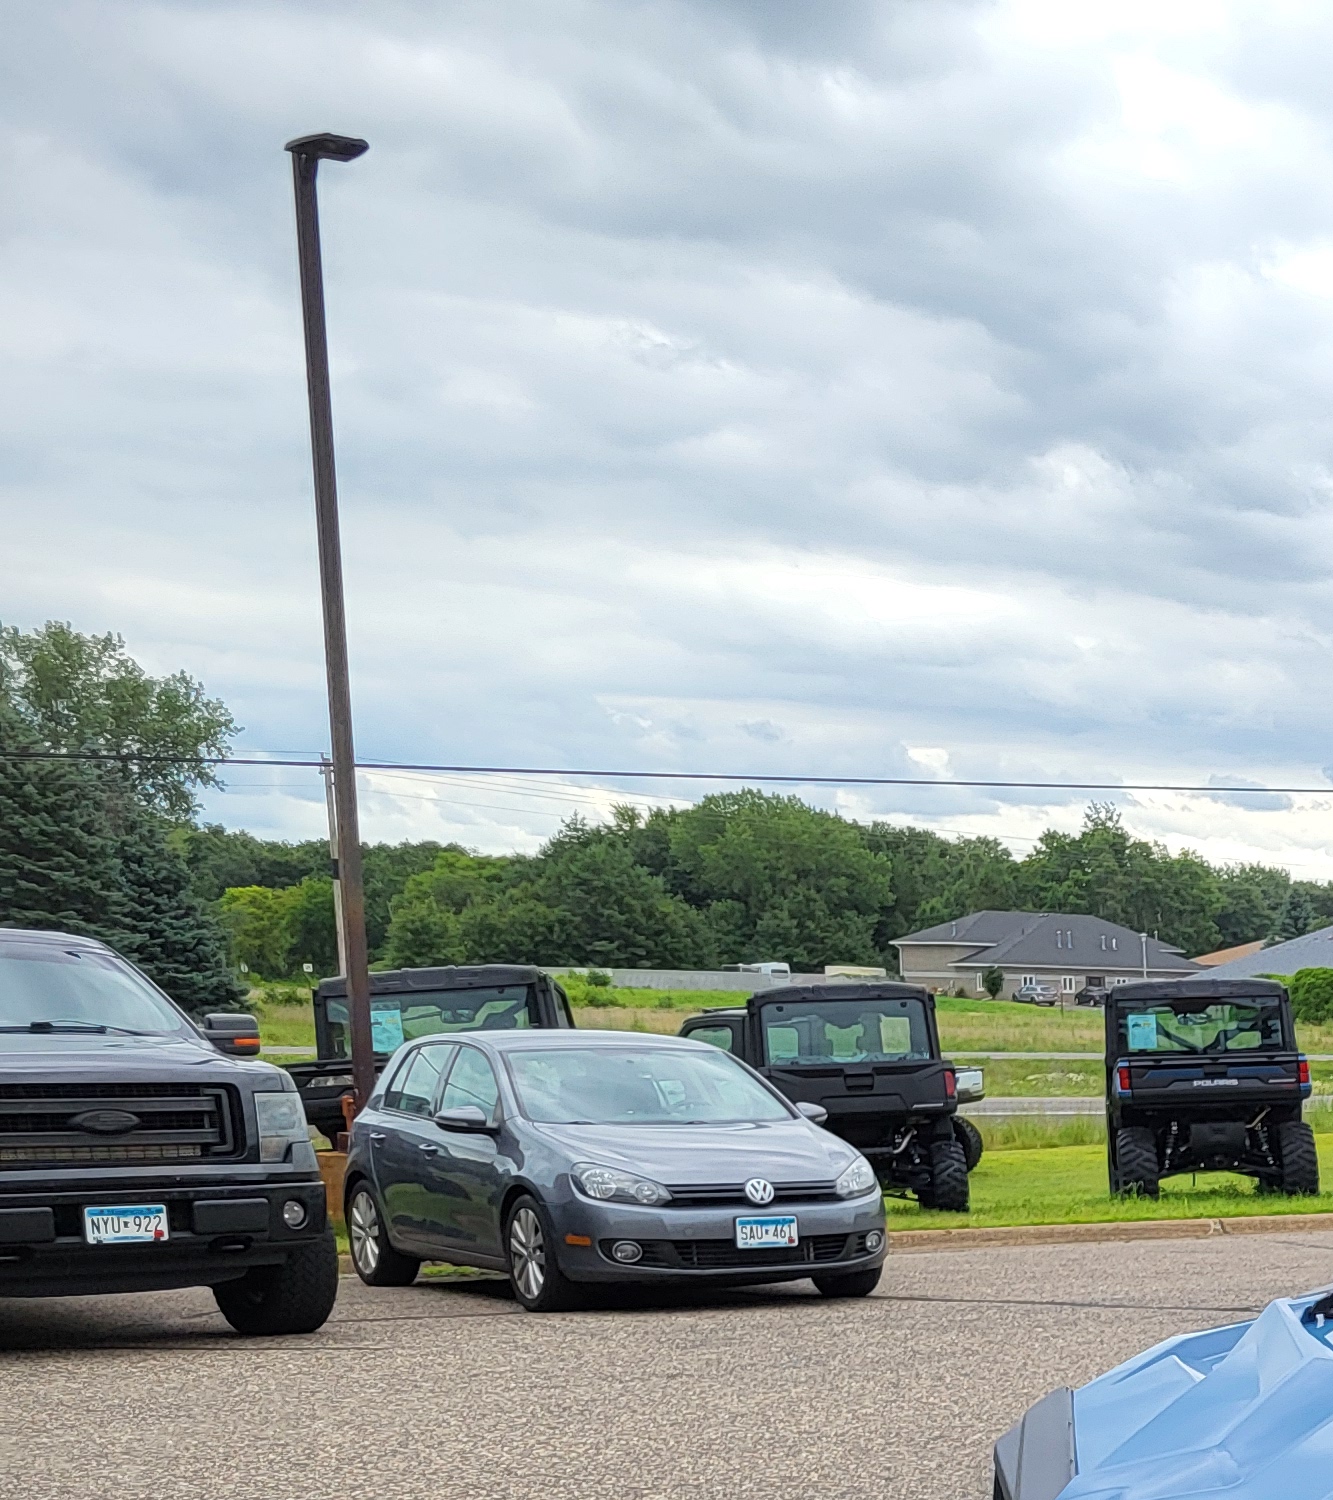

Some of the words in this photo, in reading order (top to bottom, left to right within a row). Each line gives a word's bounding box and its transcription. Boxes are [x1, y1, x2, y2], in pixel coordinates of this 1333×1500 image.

[91, 1216, 121, 1235] NYU
[133, 1215, 162, 1233] 922
[740, 1225, 763, 1241] SAU
[773, 1223, 793, 1240] 461
